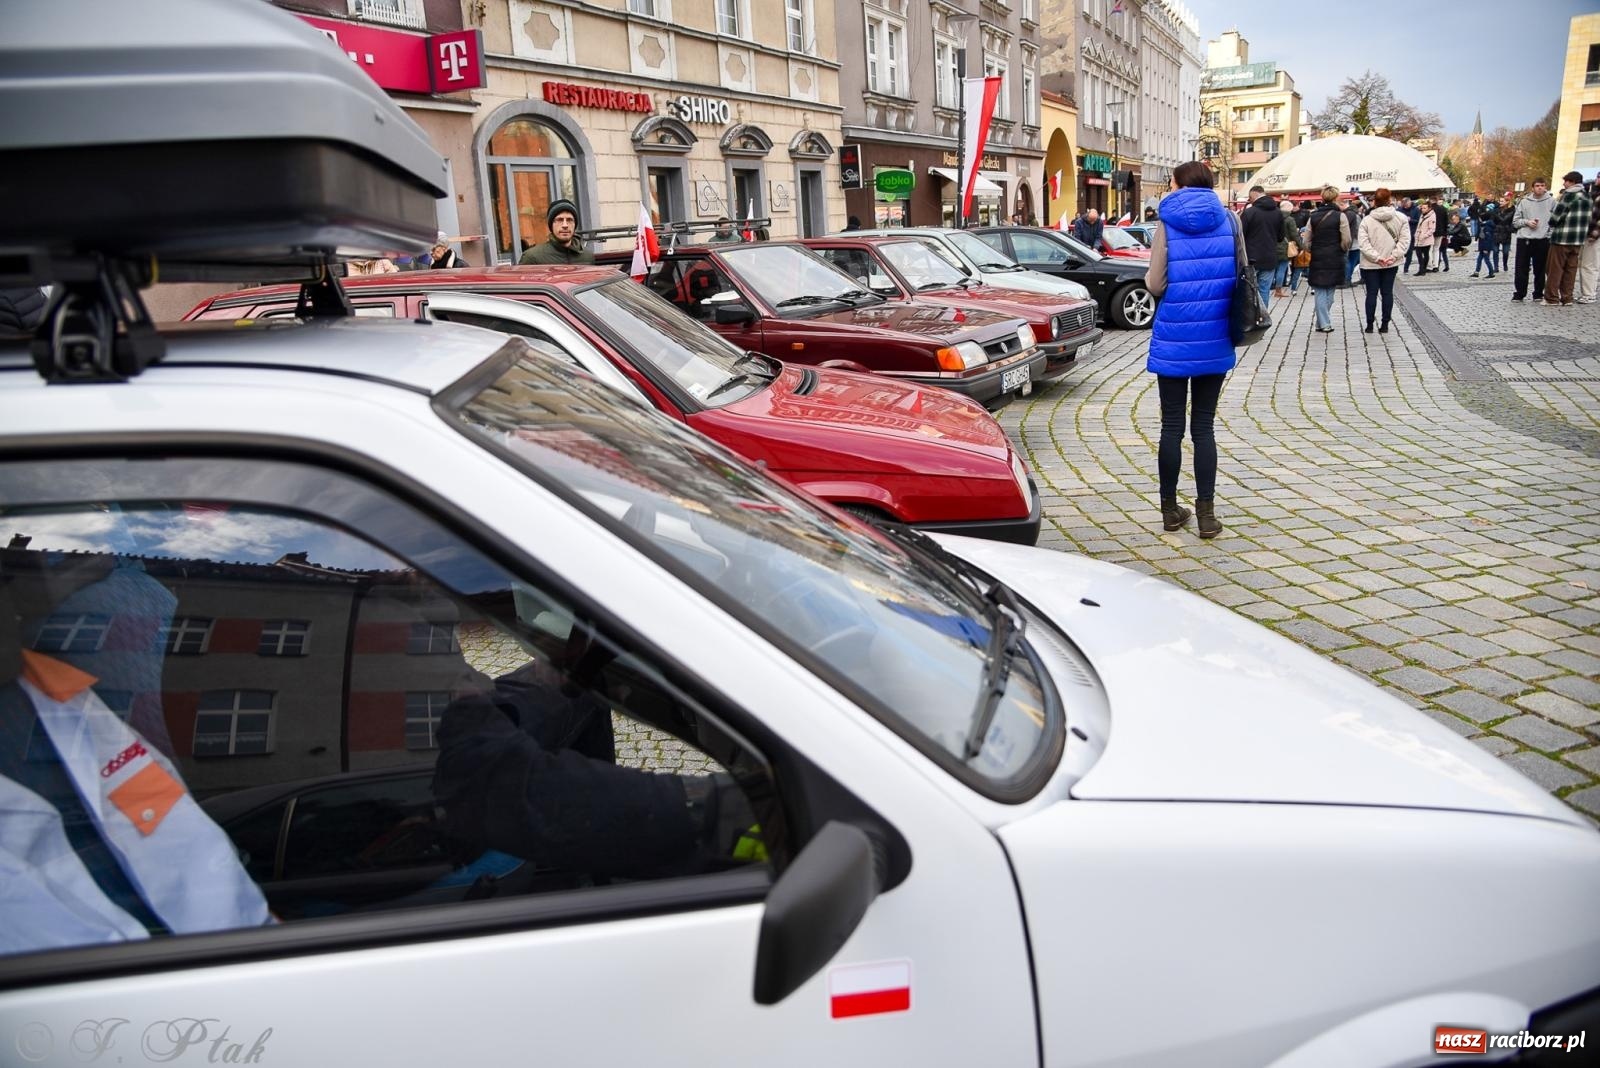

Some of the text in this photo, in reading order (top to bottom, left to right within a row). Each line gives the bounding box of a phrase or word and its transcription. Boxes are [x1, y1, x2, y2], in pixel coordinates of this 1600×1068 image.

[542, 81, 654, 113] RESTAURACJA
[679, 96, 731, 125] SHIRO
[880, 176, 910, 186] żabka
